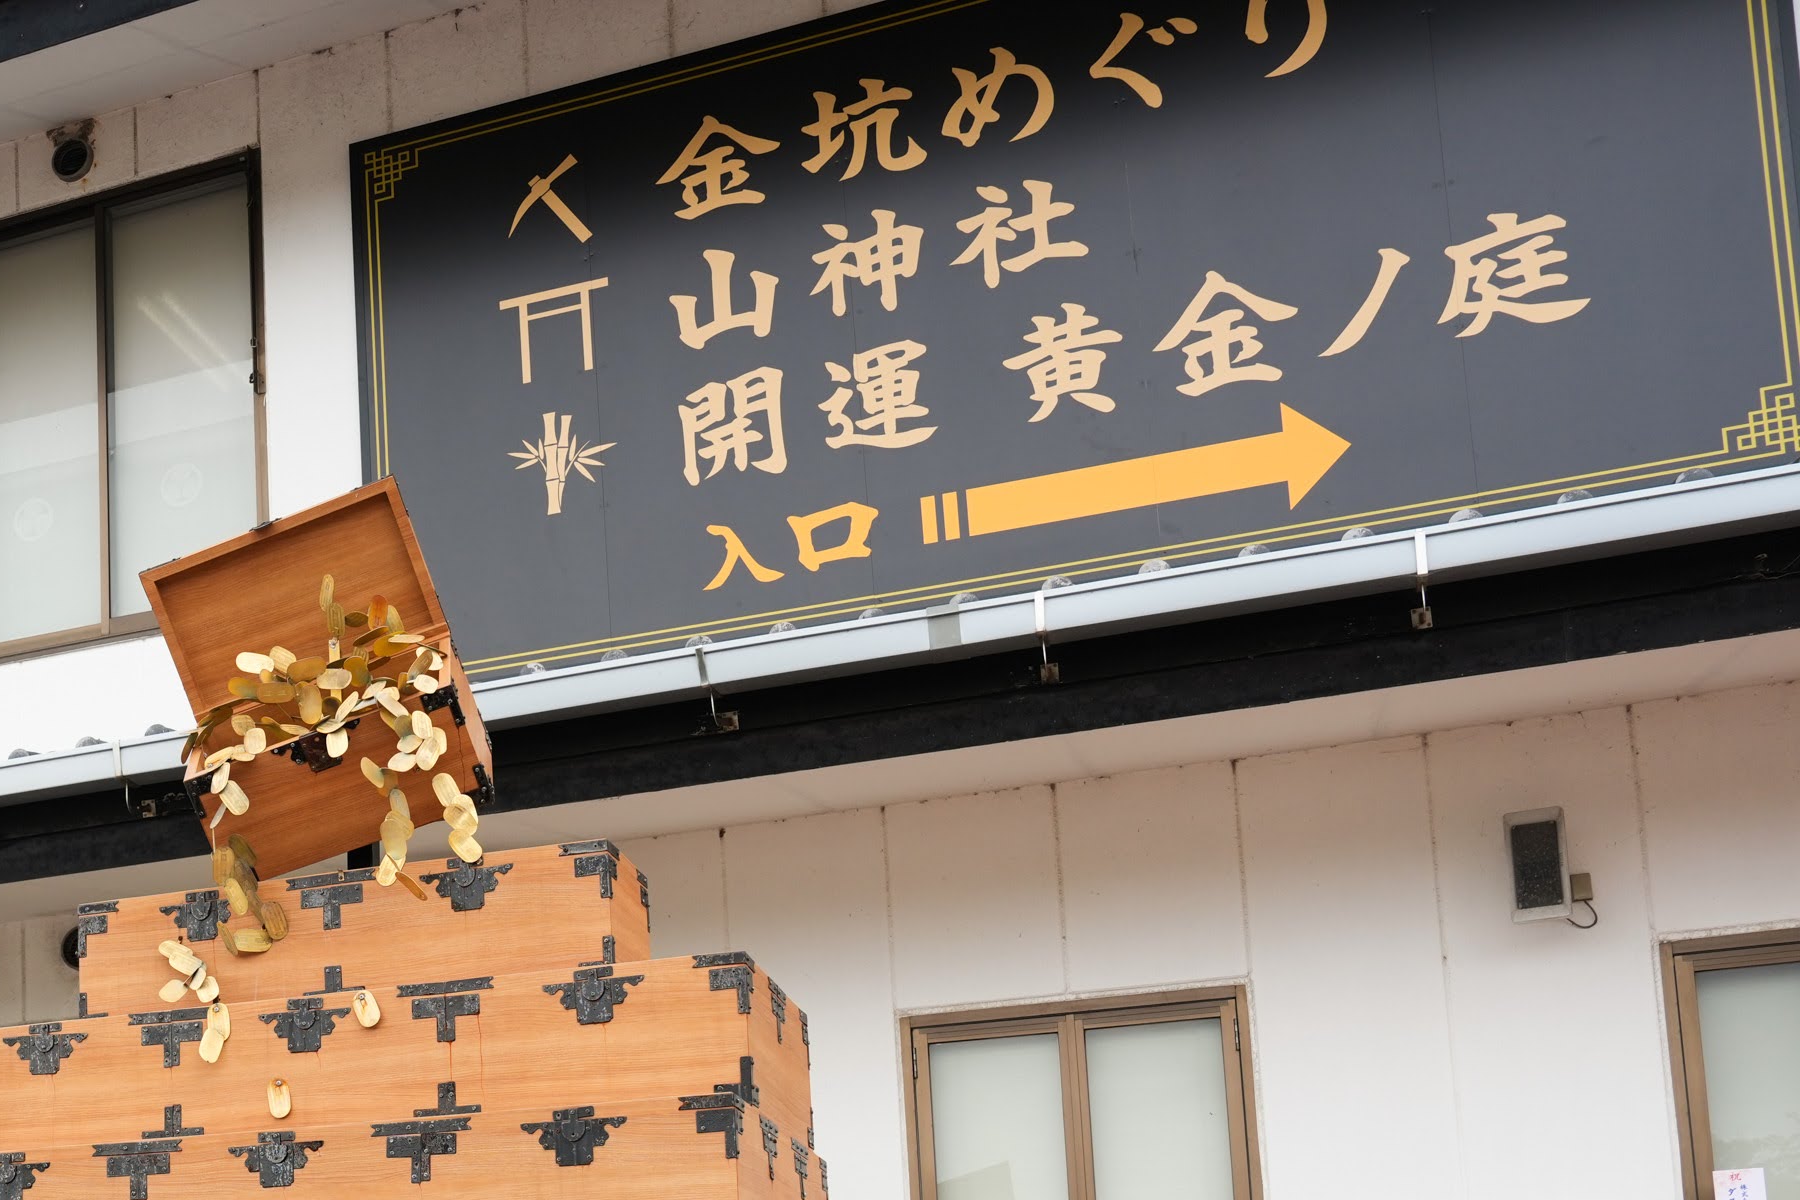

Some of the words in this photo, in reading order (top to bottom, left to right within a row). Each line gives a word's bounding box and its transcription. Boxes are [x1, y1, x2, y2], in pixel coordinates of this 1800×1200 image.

[655, 0, 1328, 220] 金坑めぐり
[668, 178, 1090, 349] 山神社
[676, 339, 940, 487] 開運
[1001, 212, 1592, 424] 黄金ノ庭
[702, 501, 880, 591] 入口
[1730, 1173, 1741, 1181] 祝
